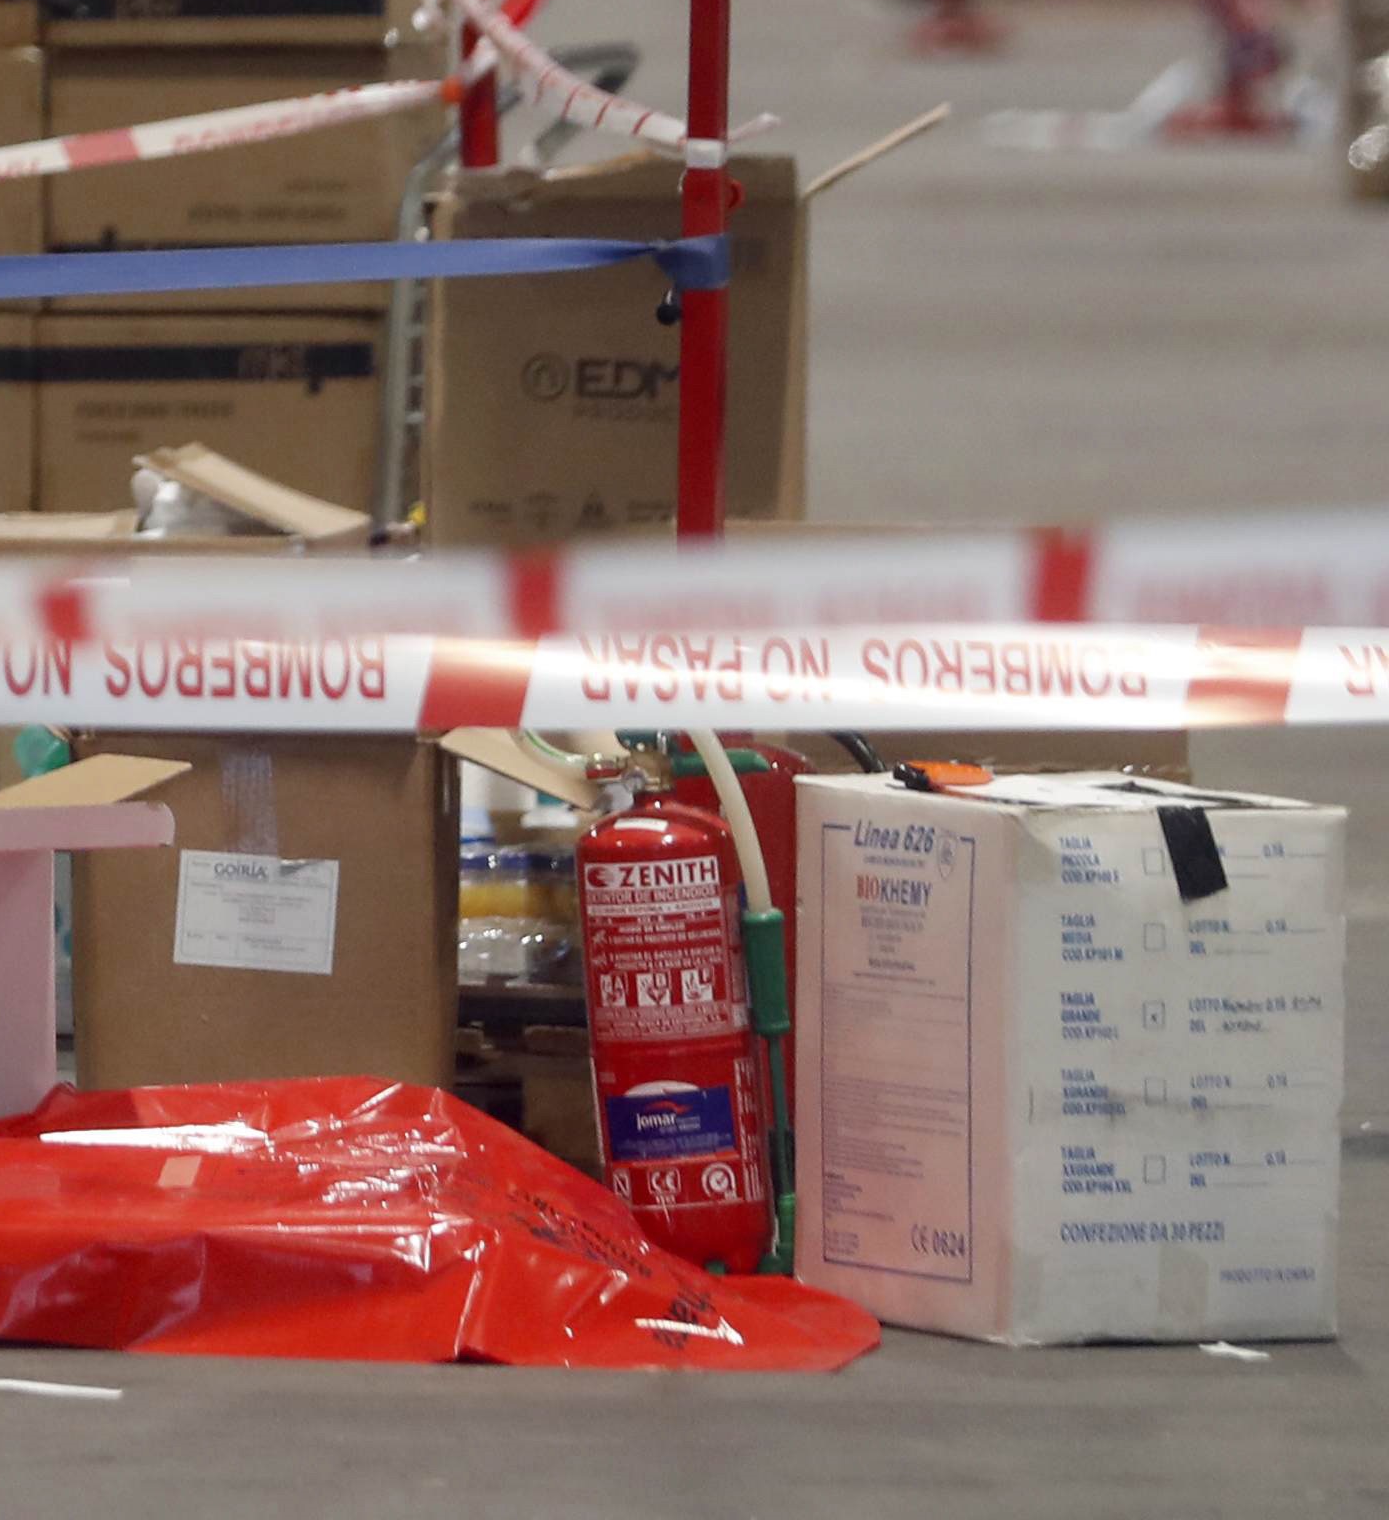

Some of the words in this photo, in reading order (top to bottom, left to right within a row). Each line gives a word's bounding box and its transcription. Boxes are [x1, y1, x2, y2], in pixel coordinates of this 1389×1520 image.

[3, 634, 71, 698] NO
[105, 630, 387, 701] BOMBEROS
[578, 632, 743, 702] PASAR
[766, 635, 829, 702] NO
[862, 635, 1149, 700] BOMBEROS
[854, 818, 901, 851] Linea
[904, 823, 936, 854] 626
[620, 859, 717, 888] ZENITH
[653, 885, 717, 902] INCENDIOS
[855, 874, 932, 906] BIOKHEMY
[1060, 1221, 1148, 1244] CONFEZIONE
